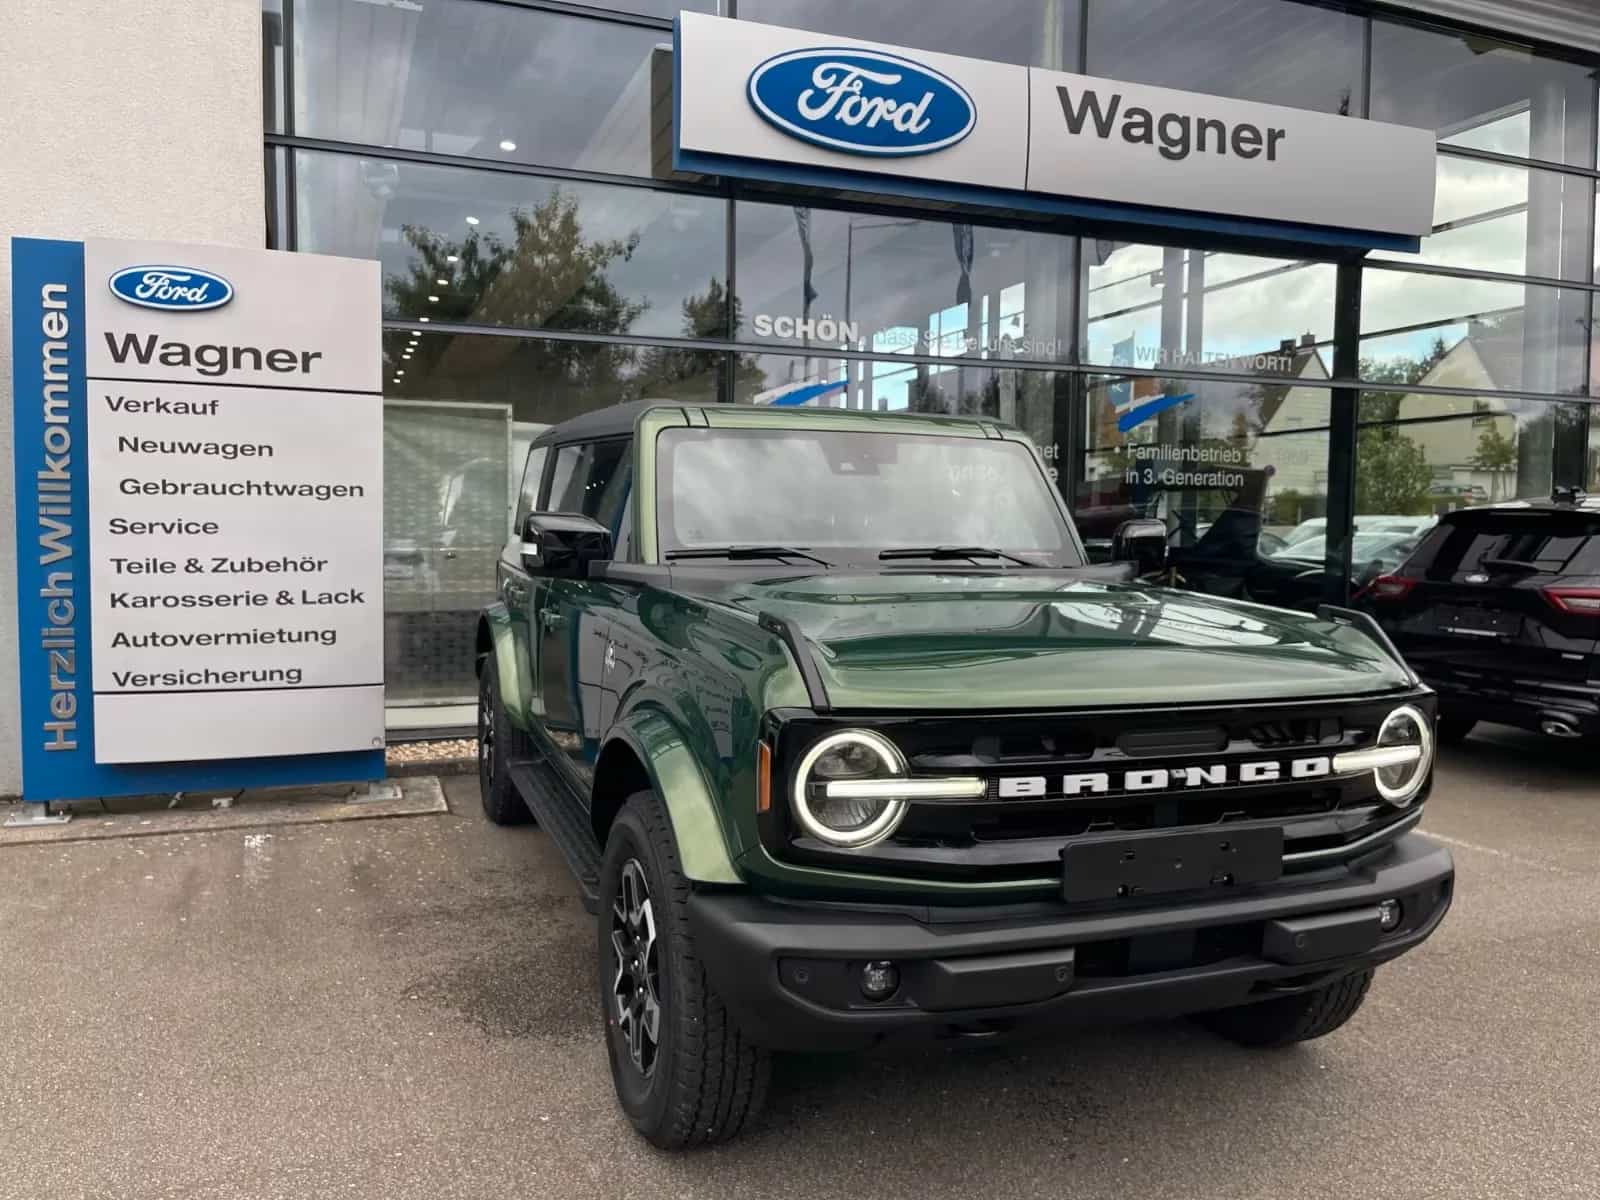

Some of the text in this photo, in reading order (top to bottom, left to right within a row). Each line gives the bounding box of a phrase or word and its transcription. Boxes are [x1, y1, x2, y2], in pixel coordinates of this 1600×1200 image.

[798, 61, 931, 136] Ford
[1056, 86, 1287, 161] Wagner
[135, 271, 209, 303] Ford
[754, 313, 866, 344] SCHÖN,
[1022, 335, 1062, 357] sind!
[104, 332, 322, 376] Wagner
[1136, 345, 1168, 365] WIR
[1171, 349, 1234, 370] HALTEN
[1240, 353, 1292, 372] WORT!
[105, 395, 219, 416] Verkauf
[118, 436, 274, 460] Neuwagen
[1127, 442, 1242, 463] Familienbetrieb
[1125, 468, 1244, 487] in 3. Generation
[119, 478, 365, 501] Gebrauchtwagen
[38, 283, 77, 751] Herzlich Willkommen
[109, 518, 220, 535] Service
[110, 556, 329, 574] Teile & Zubehör
[110, 588, 366, 609] Karosserie & Lack
[111, 627, 338, 649] Autovermietung
[112, 667, 303, 687] Versicherung
[998, 756, 1331, 798] BRONCO
